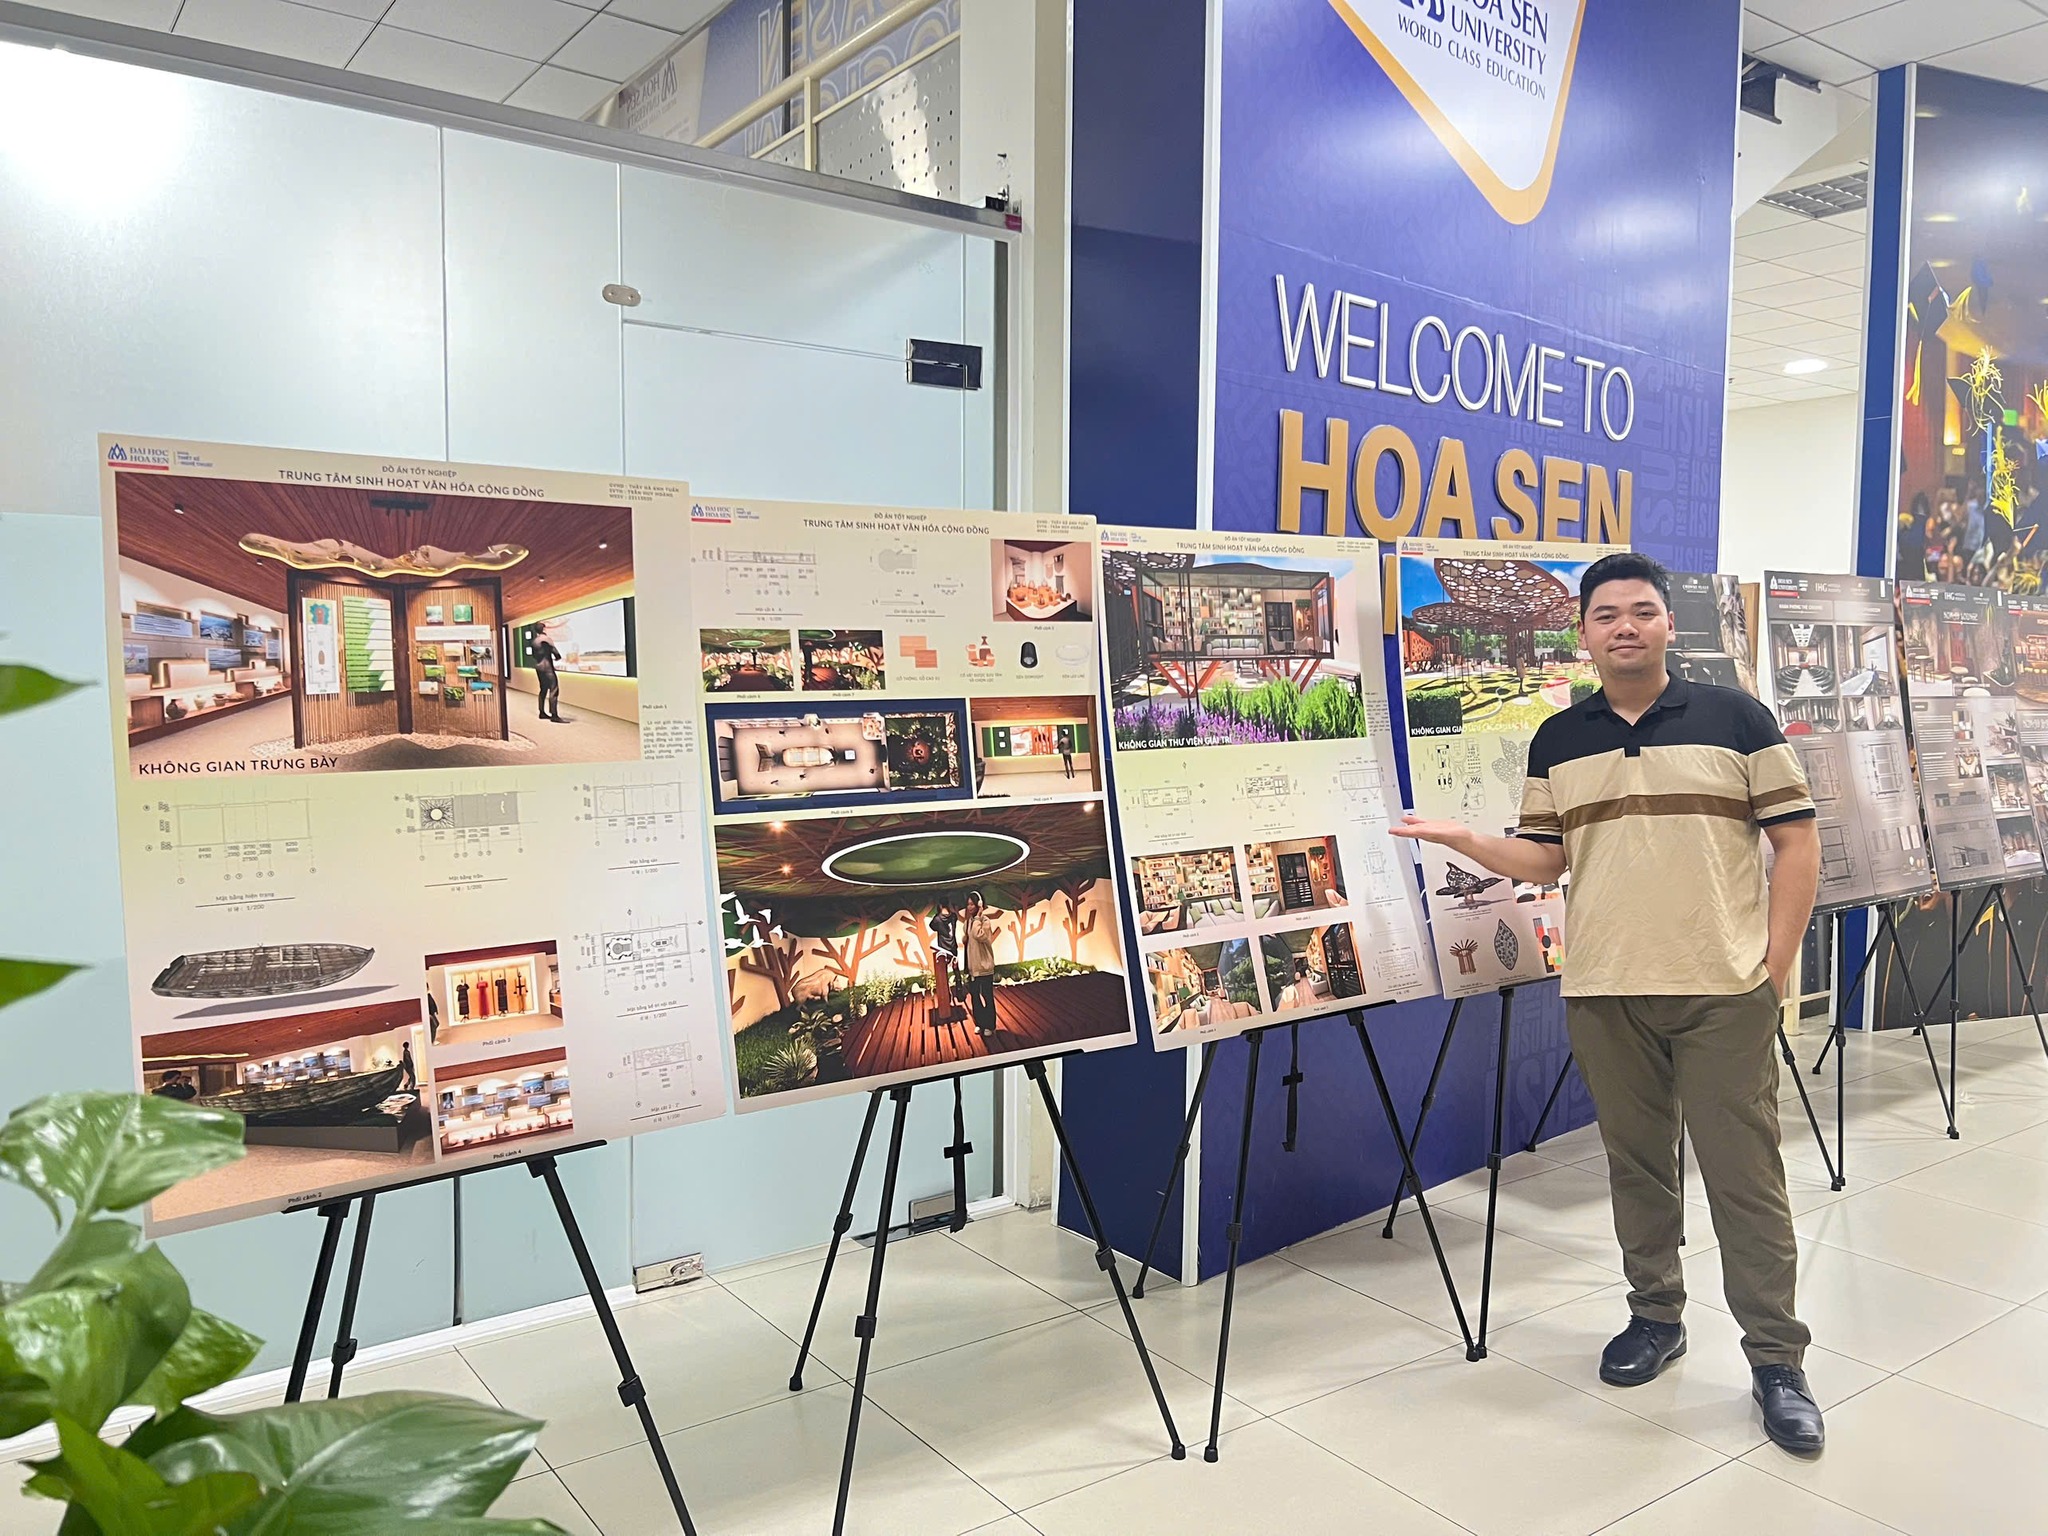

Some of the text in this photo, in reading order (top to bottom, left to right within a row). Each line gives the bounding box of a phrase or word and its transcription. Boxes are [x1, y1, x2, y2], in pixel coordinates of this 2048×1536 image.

[1511, 0, 1548, 44] SEN
[1451, 5, 1547, 75] UNIVERSITY
[1398, 13, 1546, 100] WORLD CLASS EDUCATION
[1275, 274, 1634, 441] WELCOME TO
[382, 465, 457, 478] ĐỒ ÁN TỐT NGHIỆP
[1276, 408, 1633, 543] HOA SEN
[278, 469, 545, 498] TRUNG TÂM SINH HOẠT VĂN HÓA CỘNG ĐỒNG
[803, 519, 833, 528] TRUNG
[835, 519, 854, 529] TÂM
[855, 521, 876, 530] SINH
[902, 522, 920, 532] VĂN
[922, 523, 941, 533] HÓA
[941, 524, 965, 534] CỘNG
[966, 525, 990, 535] ĐỒNG
[1176, 542, 1197, 550] TRUNG
[1198, 542, 1211, 550] TÂM
[1212, 543, 1227, 551] SINH
[1257, 544, 1270, 553] HÓA
[1271, 545, 1288, 554] CỘNG
[1288, 545, 1305, 554] ĐỒNG
[1815, 582, 1828, 592] IHG
[1411, 725, 1435, 736] KHÔNG
[1435, 725, 1452, 734] GIAN
[1118, 739, 1148, 750] KHÔNG
[1148, 738, 1168, 749] GIAN
[1168, 737, 1185, 747] THƯ
[1185, 736, 1204, 747] VIỆN
[139, 755, 339, 775] KHÔNG GIAN TRƯNG BÀY
